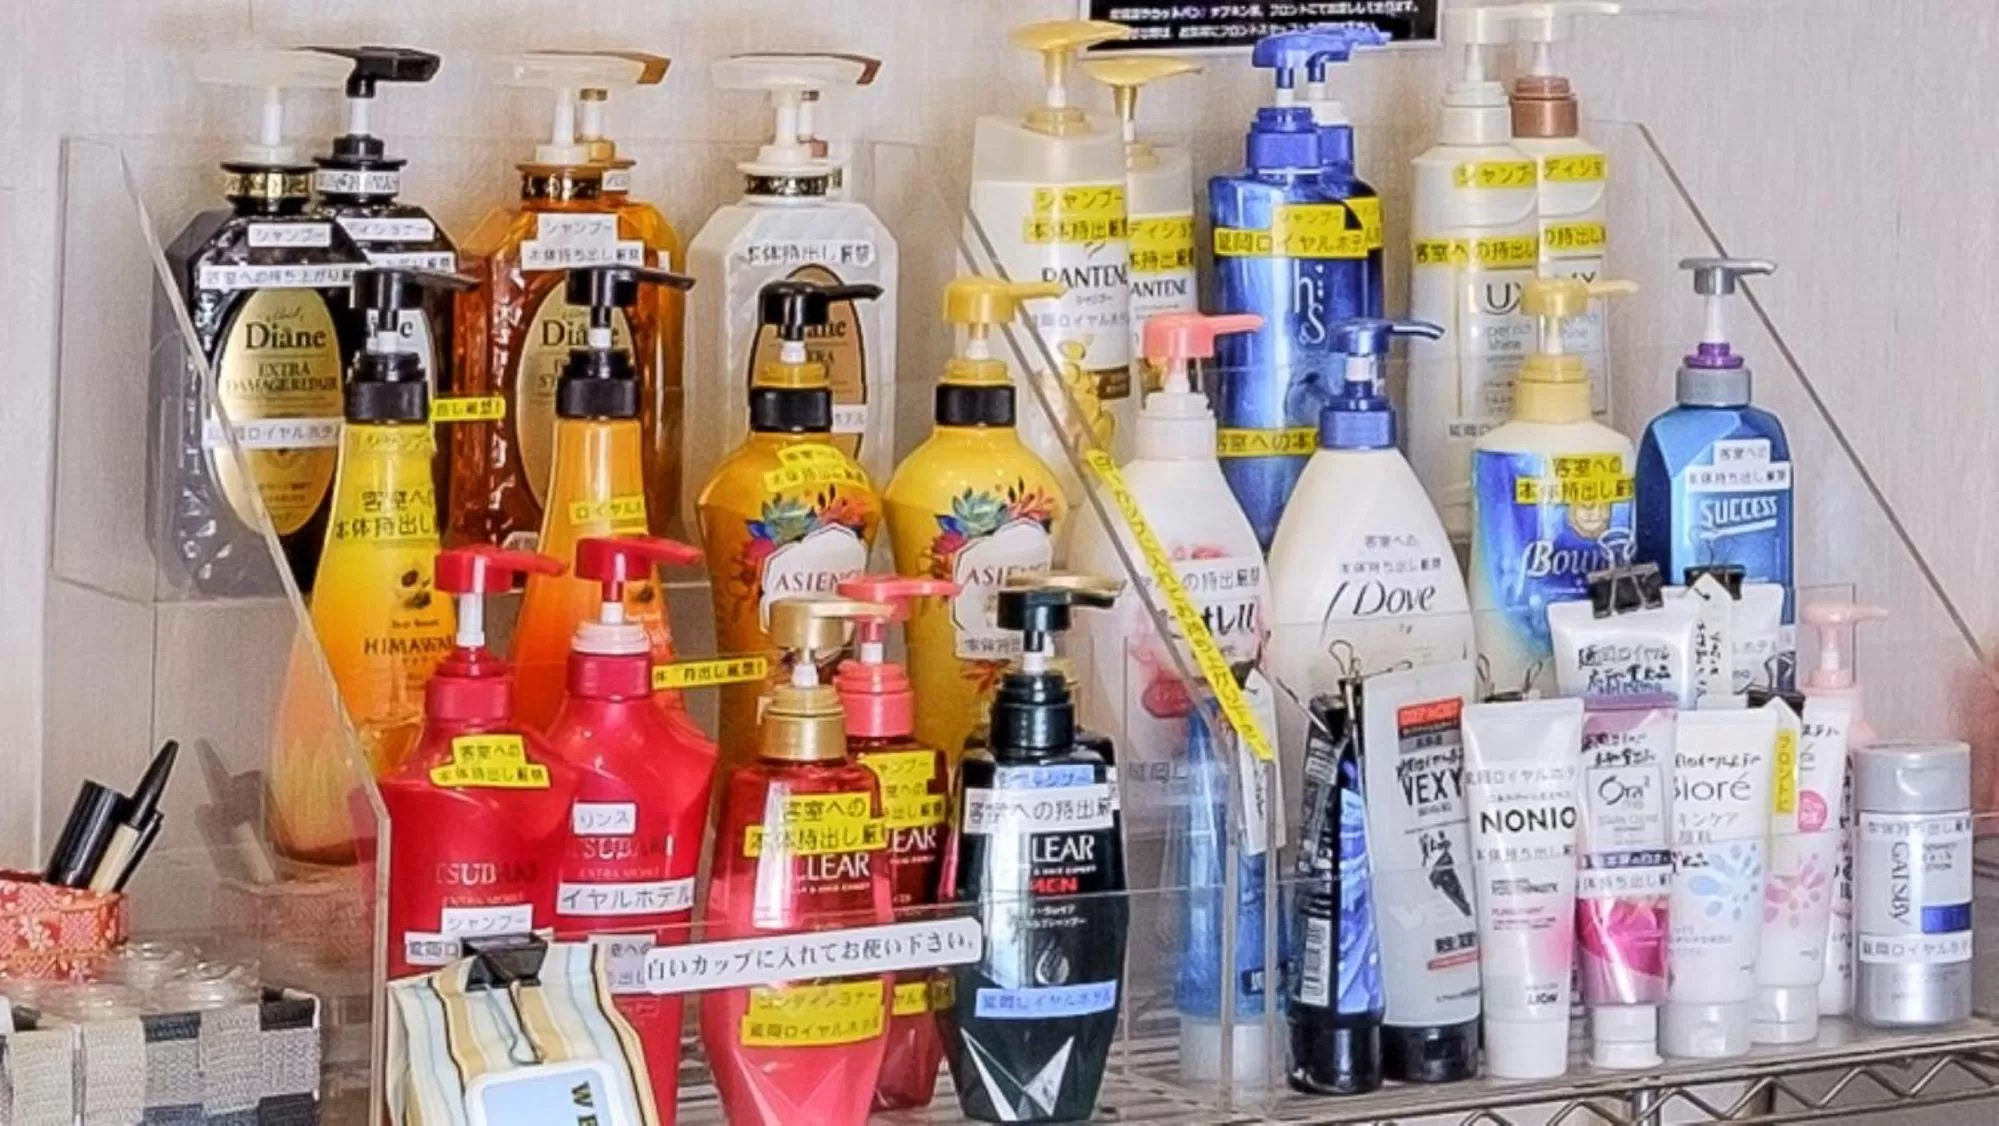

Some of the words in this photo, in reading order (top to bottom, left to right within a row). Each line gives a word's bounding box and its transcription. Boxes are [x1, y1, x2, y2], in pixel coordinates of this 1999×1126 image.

[1039, 190, 1125, 209] シャンプー
[255, 229, 327, 243] シャンプー
[1699, 495, 1778, 530] SUCCESS
[1352, 577, 1436, 616] Dove
[1401, 766, 1463, 806] VEXY
[579, 809, 630, 830] リンス
[1479, 805, 1578, 834] NONIO
[564, 883, 691, 912] イヤルホテル
[1889, 841, 1911, 925] GATSBY
[448, 914, 528, 931] シャンプー
